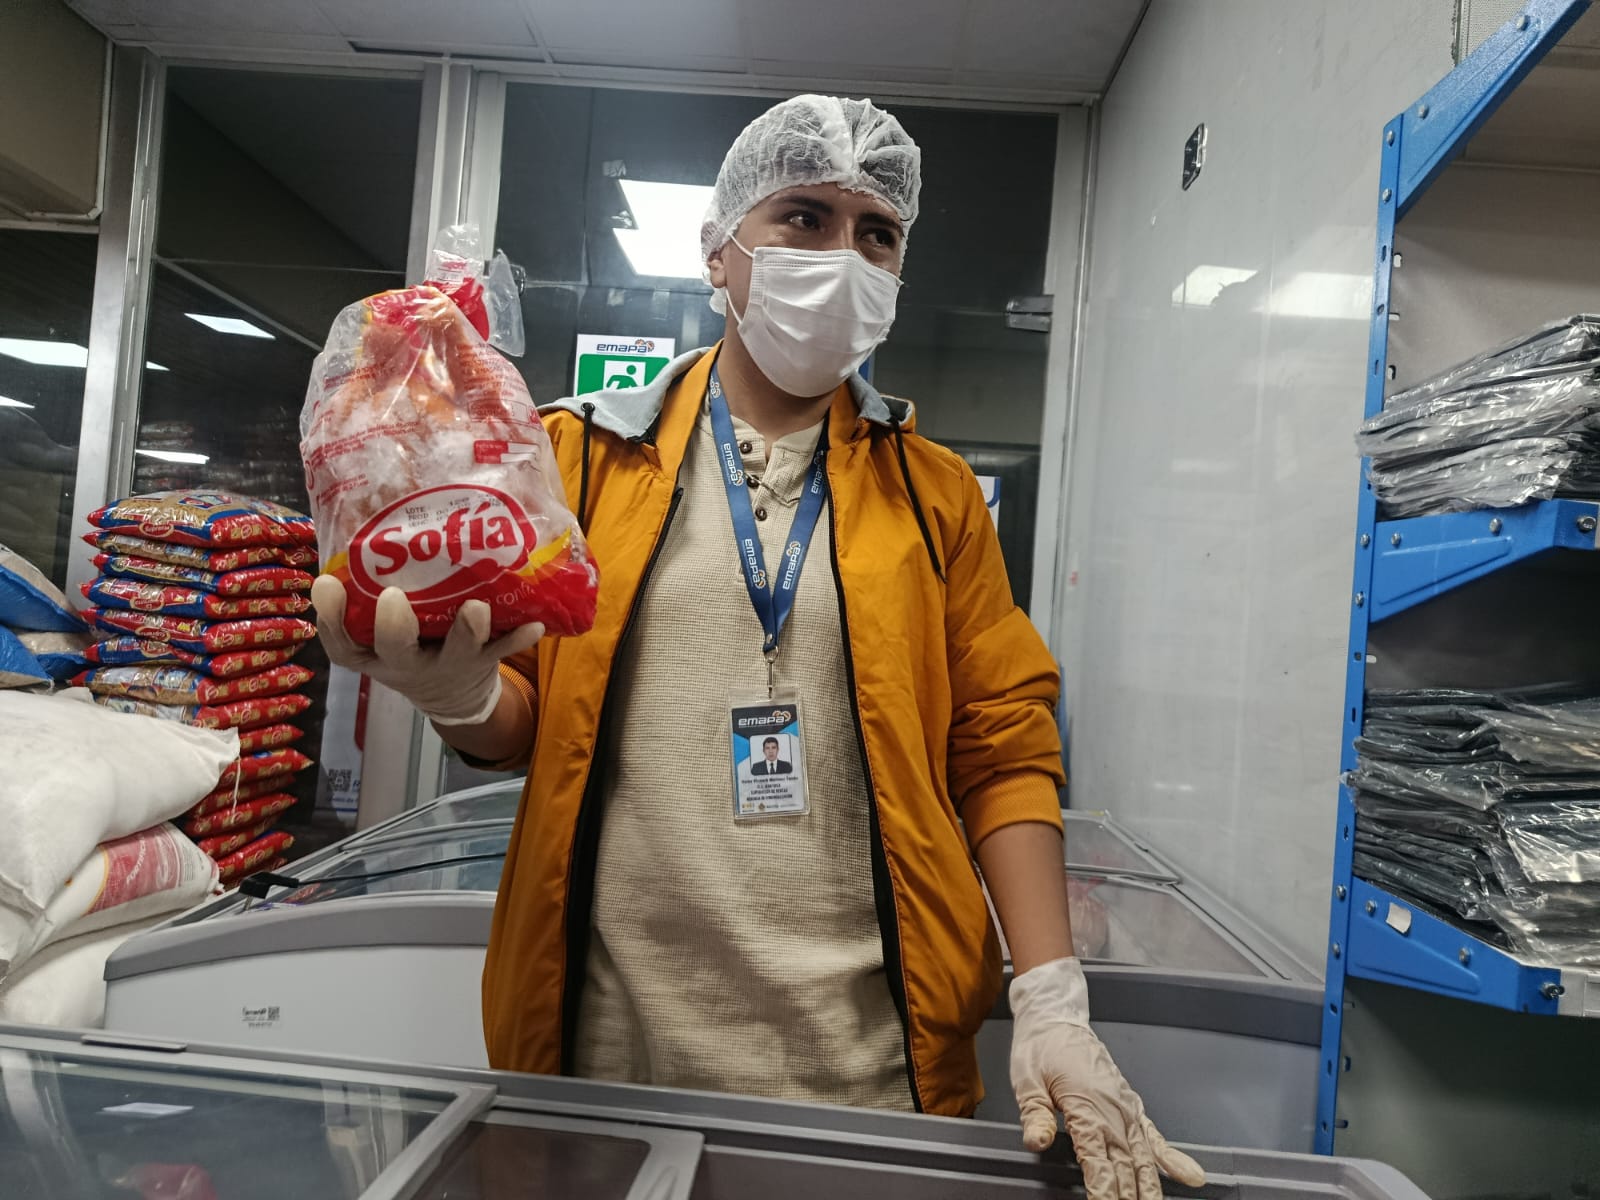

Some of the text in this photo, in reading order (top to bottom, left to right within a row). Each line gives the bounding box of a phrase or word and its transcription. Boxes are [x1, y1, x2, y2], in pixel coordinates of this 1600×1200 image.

[597, 343, 647, 353] emapa
[723, 443, 738, 485] emapa
[369, 501, 518, 575] Sofía
[745, 539, 760, 586] emapa
[782, 546, 801, 590] emapa
[738, 716, 784, 726] emapa
